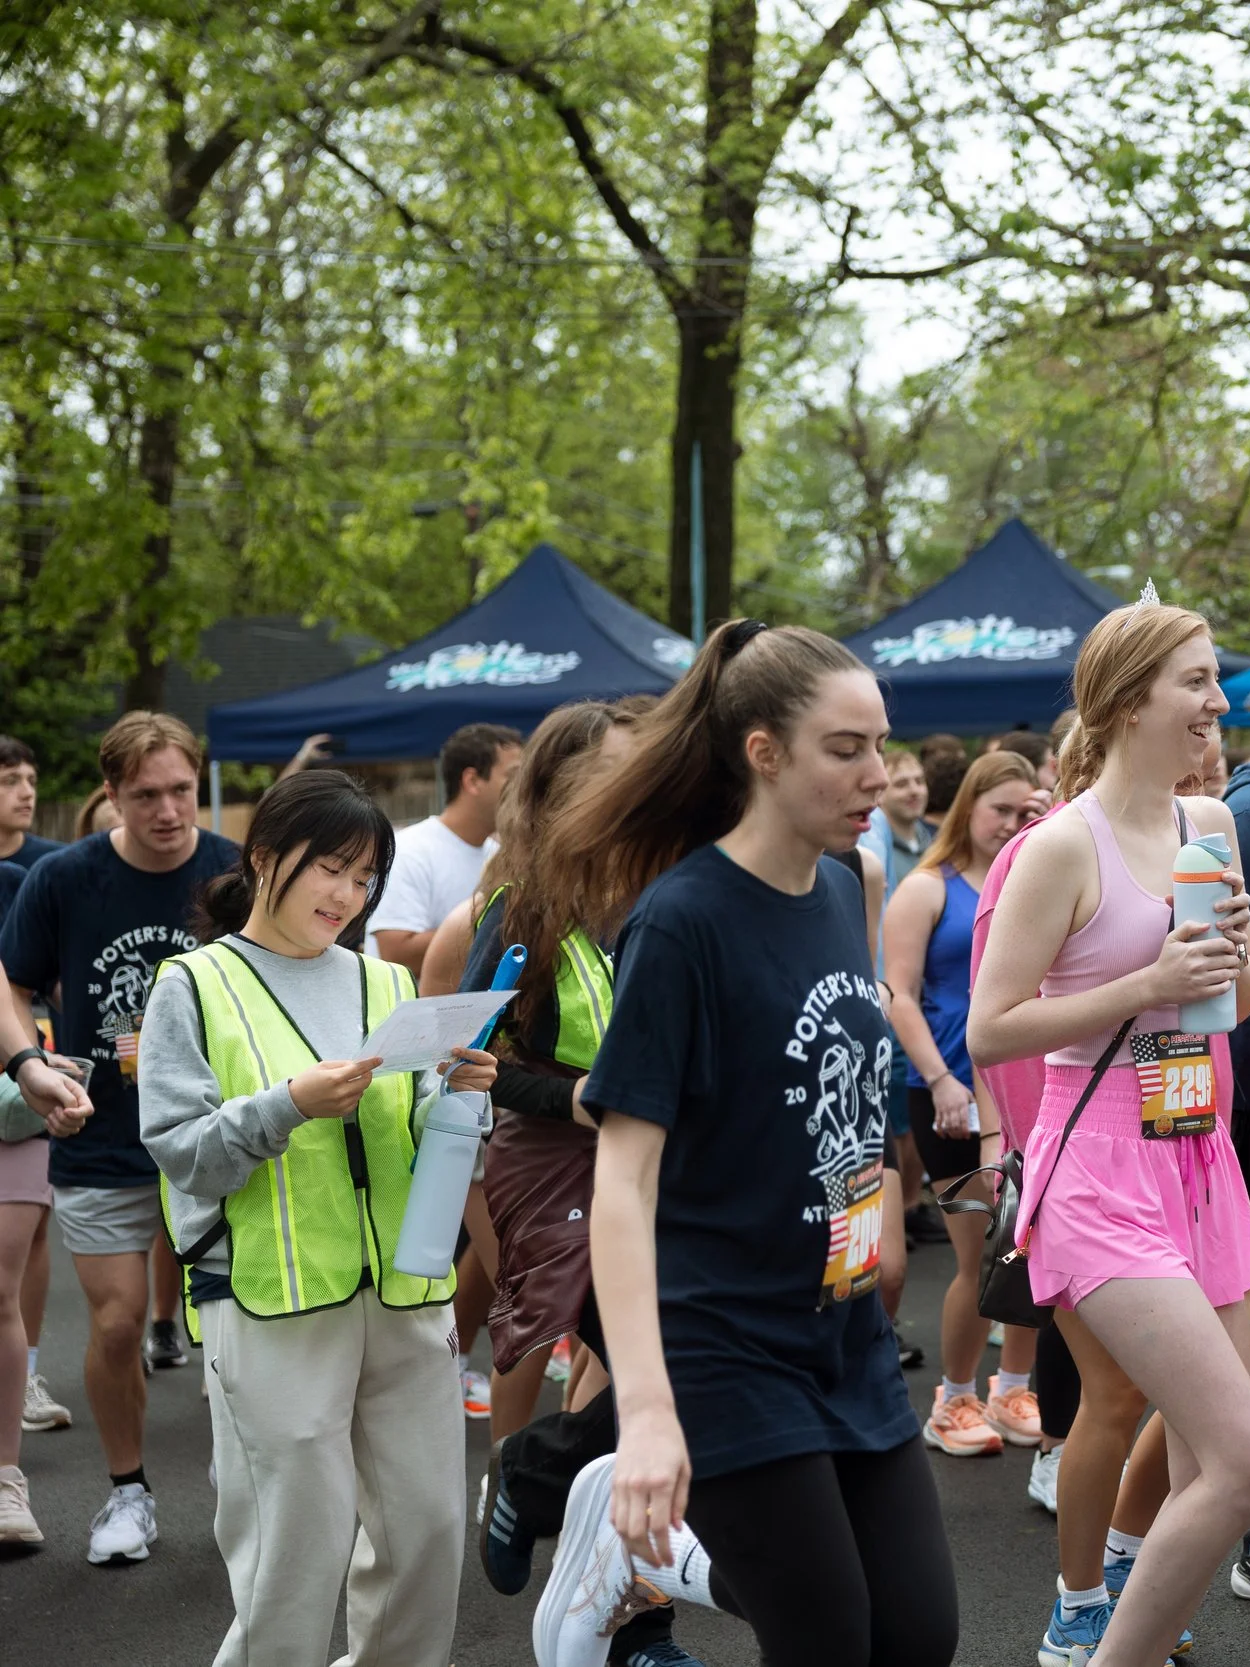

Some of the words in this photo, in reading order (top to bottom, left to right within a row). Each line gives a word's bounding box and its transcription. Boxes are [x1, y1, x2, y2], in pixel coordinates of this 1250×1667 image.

[92, 925, 168, 974] POTTER'S
[171, 927, 203, 951] HO
[88, 983, 102, 995] 20
[785, 970, 853, 1063] POTTER'S
[853, 973, 882, 1010] HO
[785, 1086, 807, 1105] 20
